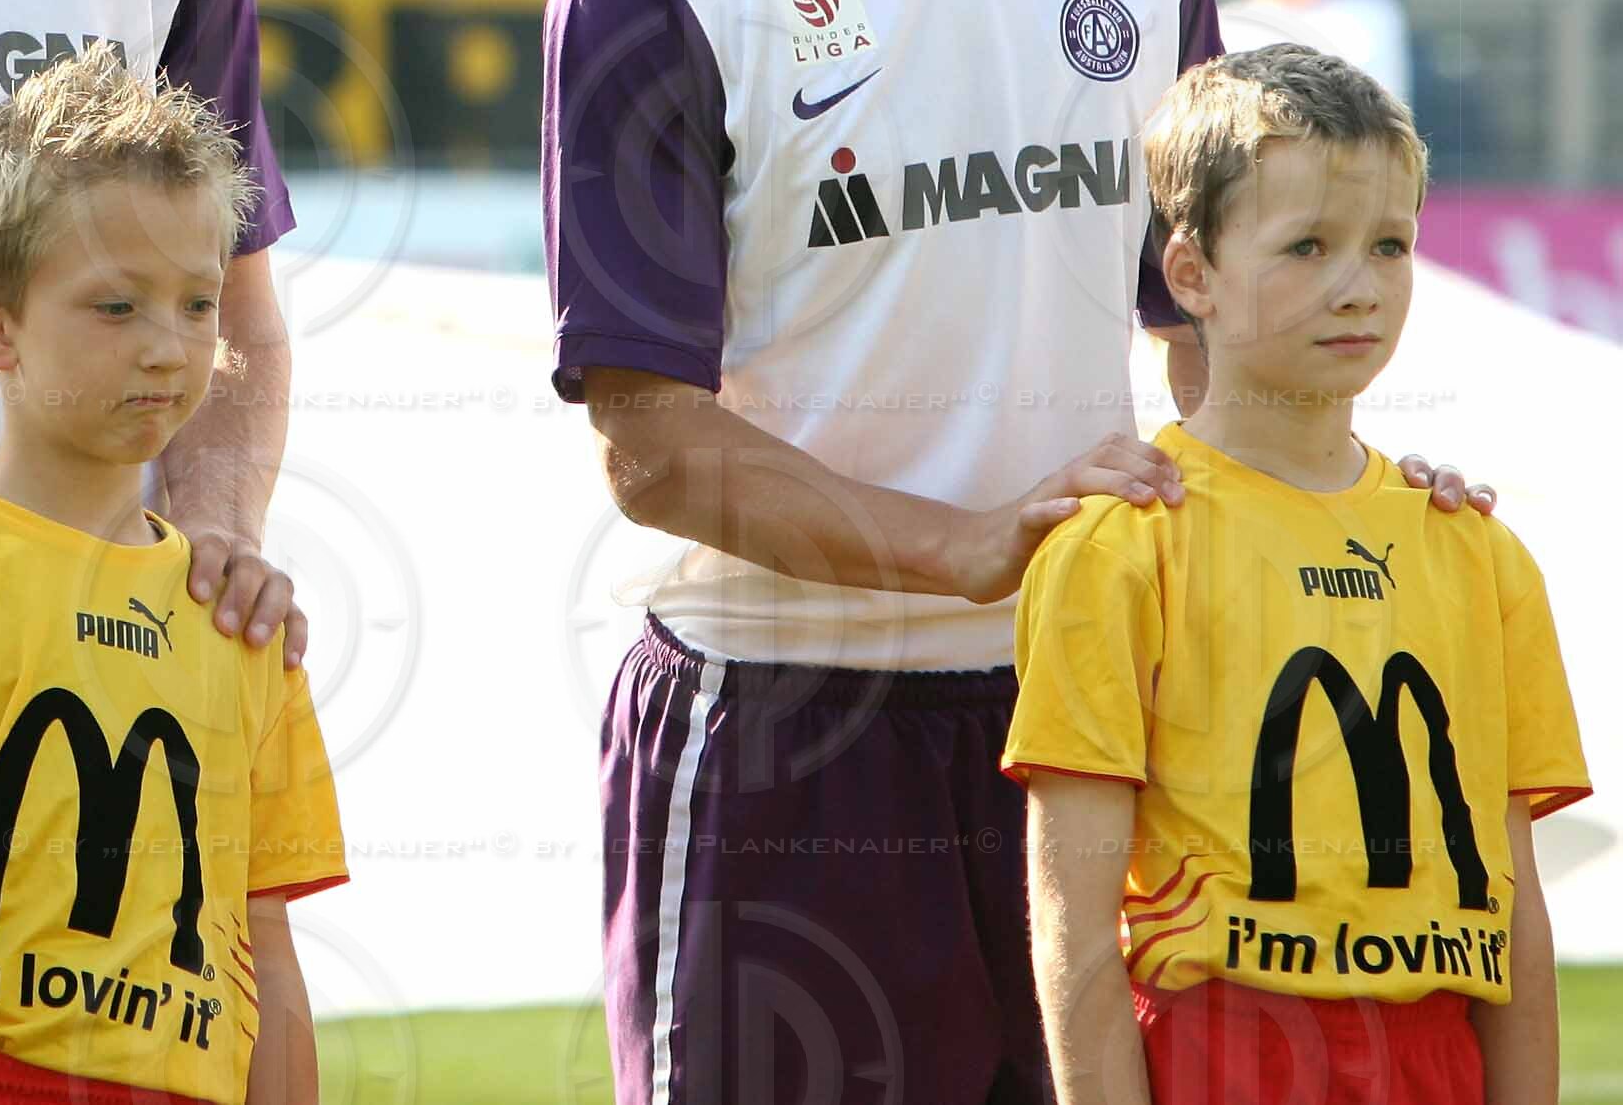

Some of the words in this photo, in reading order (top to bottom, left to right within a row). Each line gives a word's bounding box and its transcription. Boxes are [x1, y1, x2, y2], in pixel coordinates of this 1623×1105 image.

[793, 23, 866, 44] BUNDES
[795, 35, 871, 62] LIGA
[902, 138, 1130, 230] MAGN
[1298, 567, 1384, 600] PUMA
[76, 612, 159, 660] PUMA
[1226, 916, 1317, 974] i'm
[1335, 921, 1472, 977] lovin'
[20, 953, 172, 1031] lovin'
